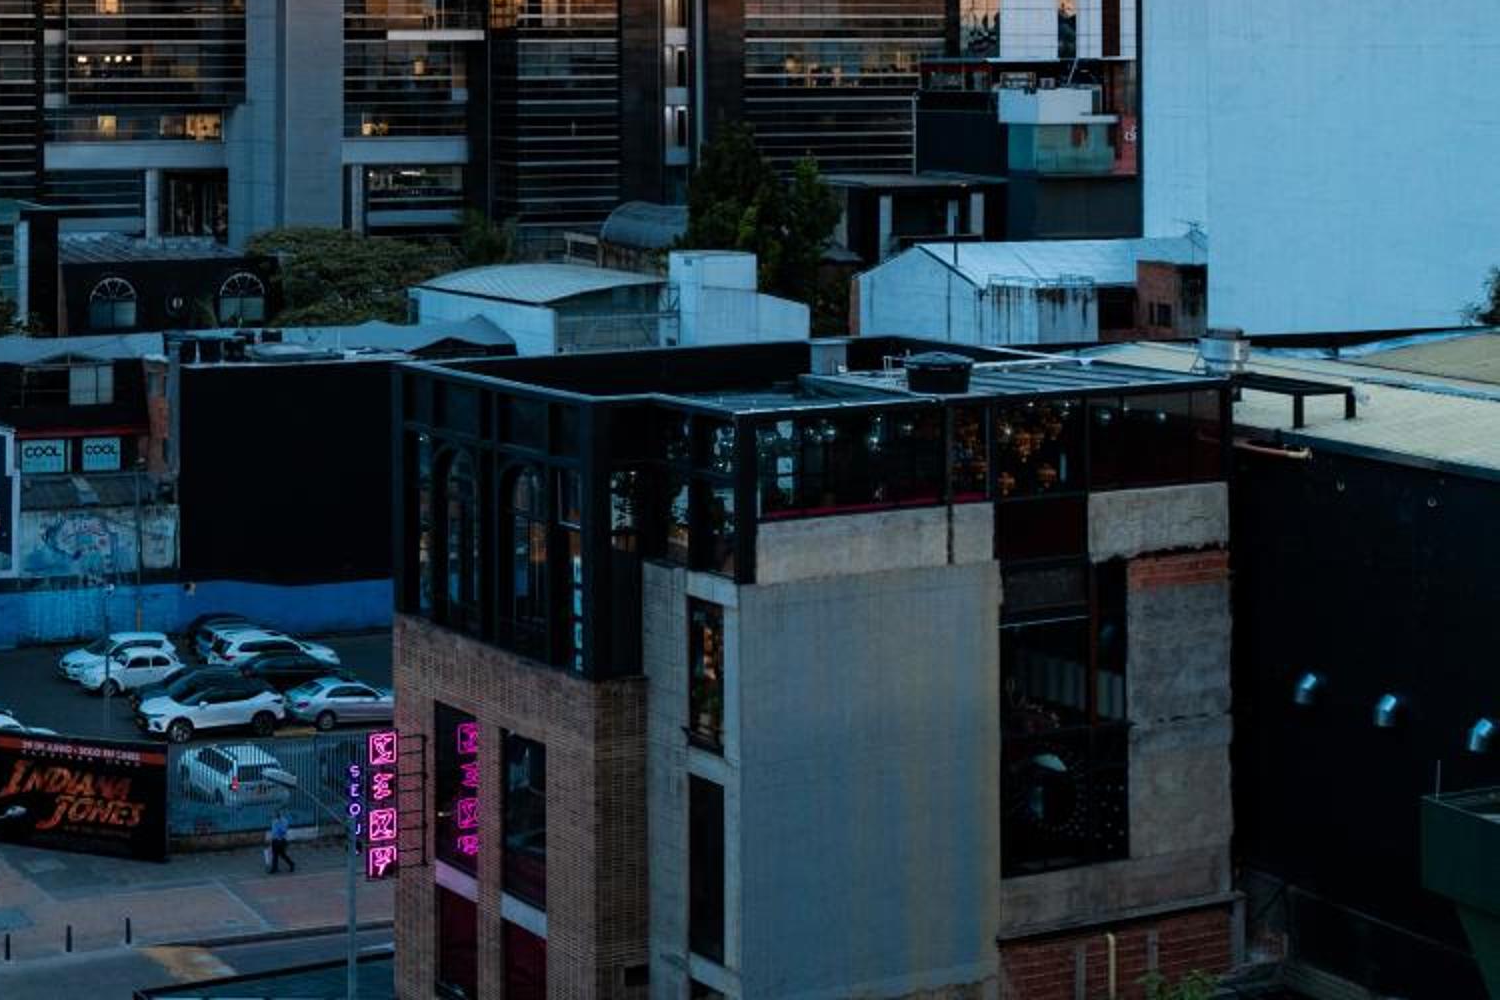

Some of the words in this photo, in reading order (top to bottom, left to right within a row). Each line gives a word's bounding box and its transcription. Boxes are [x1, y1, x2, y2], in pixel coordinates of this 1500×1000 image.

[24, 445, 62, 459] COOL
[85, 444, 117, 456] COOL
[35, 792, 147, 832] JONES
[349, 765, 362, 854] SEO
